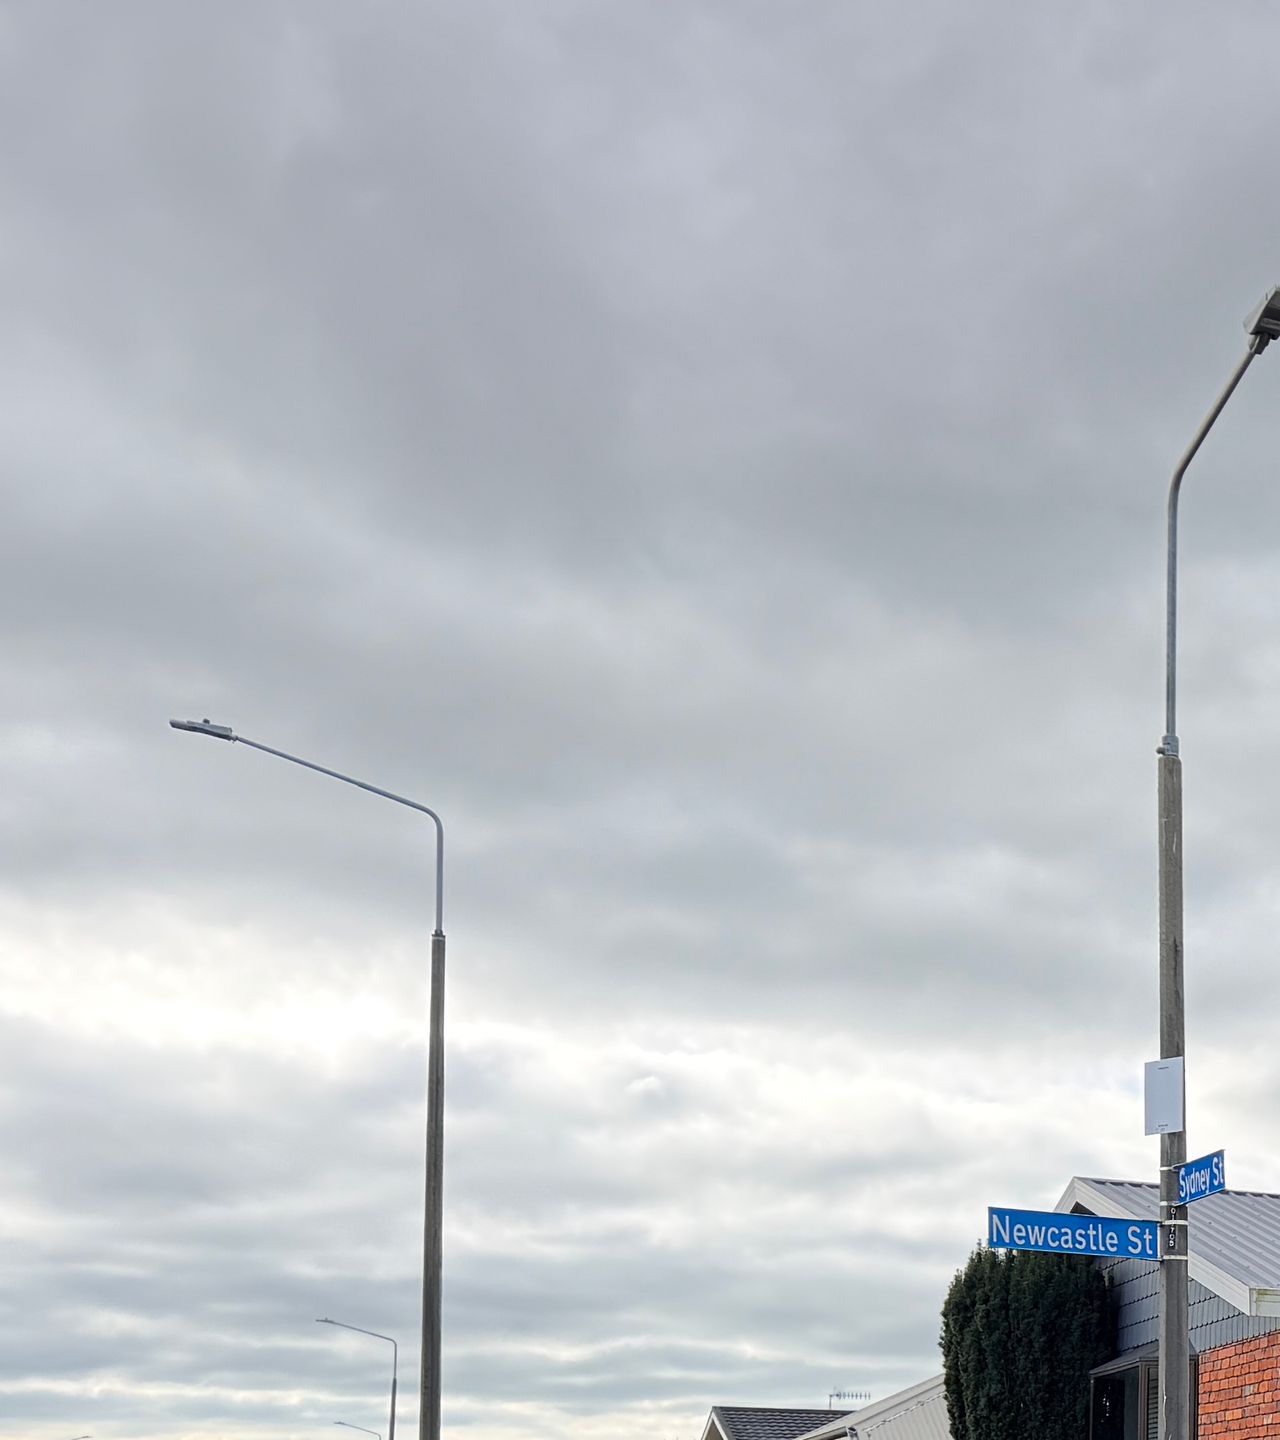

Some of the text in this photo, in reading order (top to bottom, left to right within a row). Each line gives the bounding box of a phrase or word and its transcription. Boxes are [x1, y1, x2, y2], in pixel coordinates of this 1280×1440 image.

[1179, 1156, 1224, 1201] Sydney St
[992, 1214, 1153, 1255] Newcastle St
